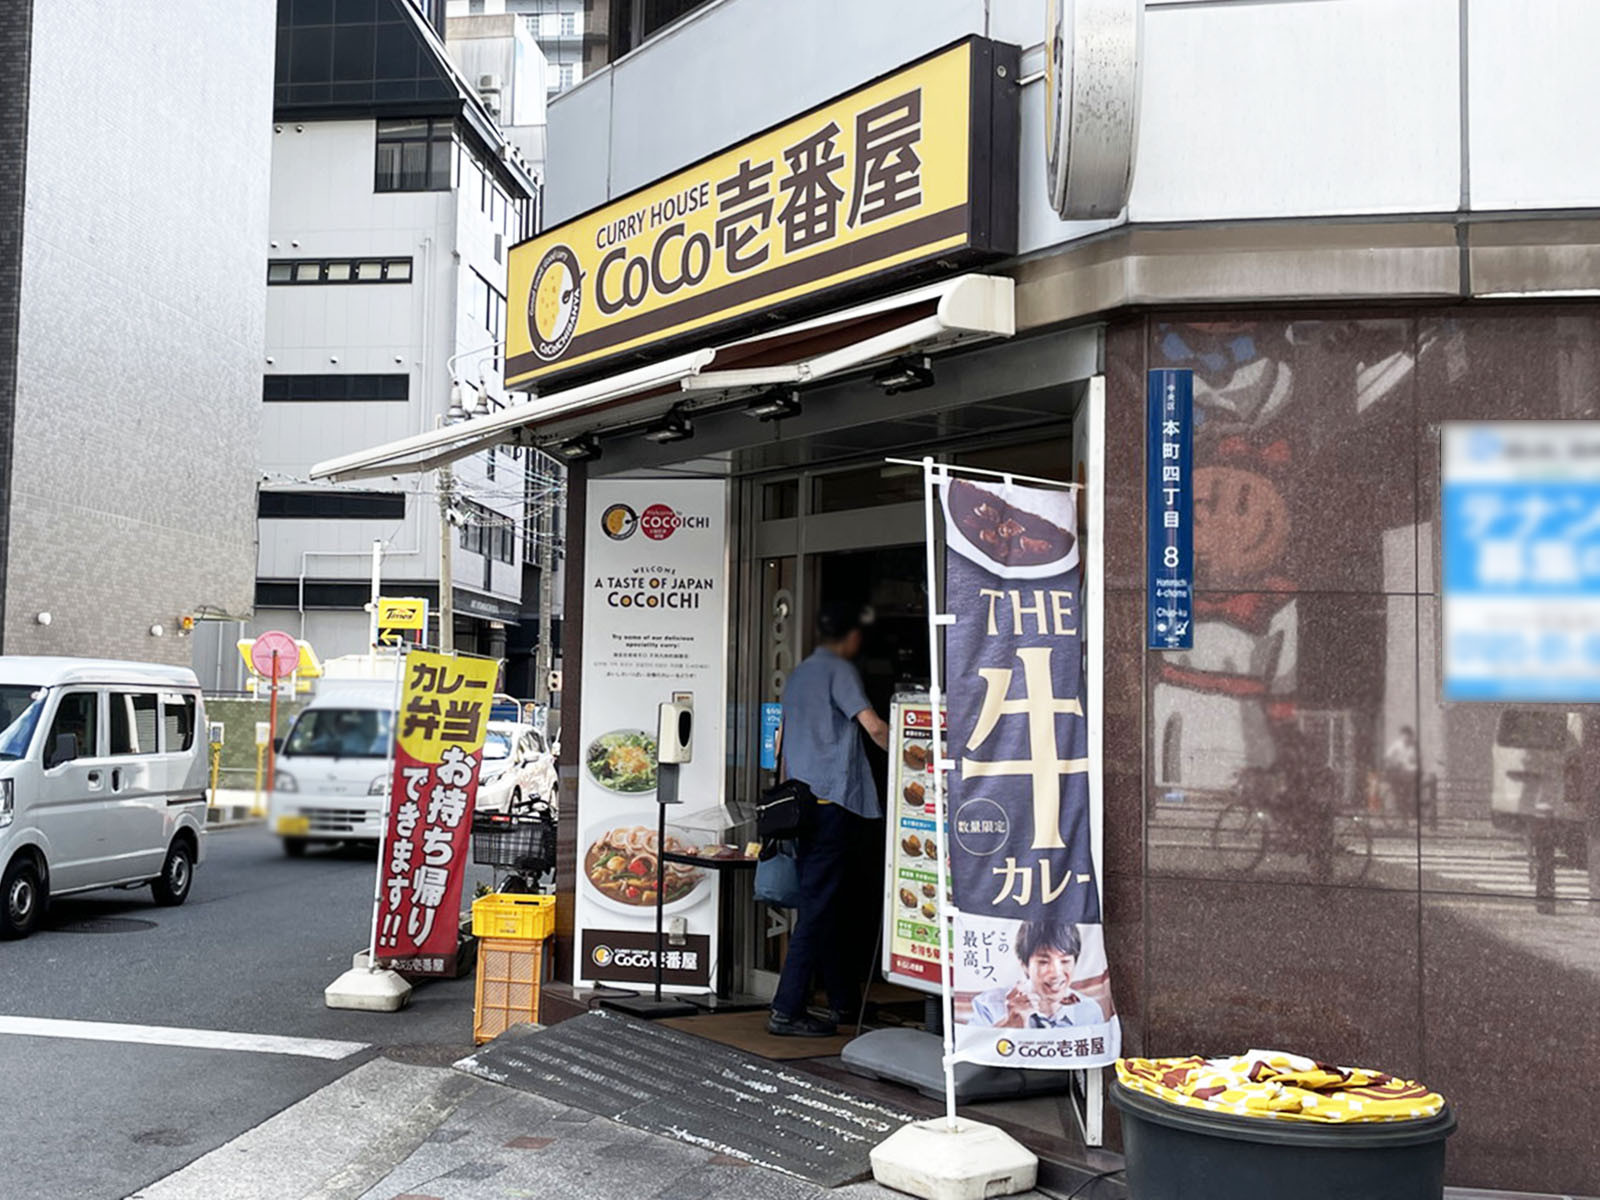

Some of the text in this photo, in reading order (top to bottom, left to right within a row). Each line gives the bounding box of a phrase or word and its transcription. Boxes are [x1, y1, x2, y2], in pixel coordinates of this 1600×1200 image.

[595, 87, 922, 316] CoCo壱番屋
[596, 182, 710, 250] CURRY HOUSE
[1162, 420, 1180, 528] 本町四丁目
[632, 566, 676, 576] WELCOME
[1163, 546, 1179, 568] 8
[595, 577, 713, 590] A TASTE OF JAPAN
[979, 588, 1077, 636] THE
[410, 662, 488, 694] カレー
[402, 696, 484, 743] 弁当
[961, 647, 1089, 850] 牛
[407, 746, 475, 947] お持ち帰り
[992, 857, 1091, 906] カレー
[998, 931, 1010, 954] この
[1018, 1036, 1105, 1058] CoCo壱番屋
